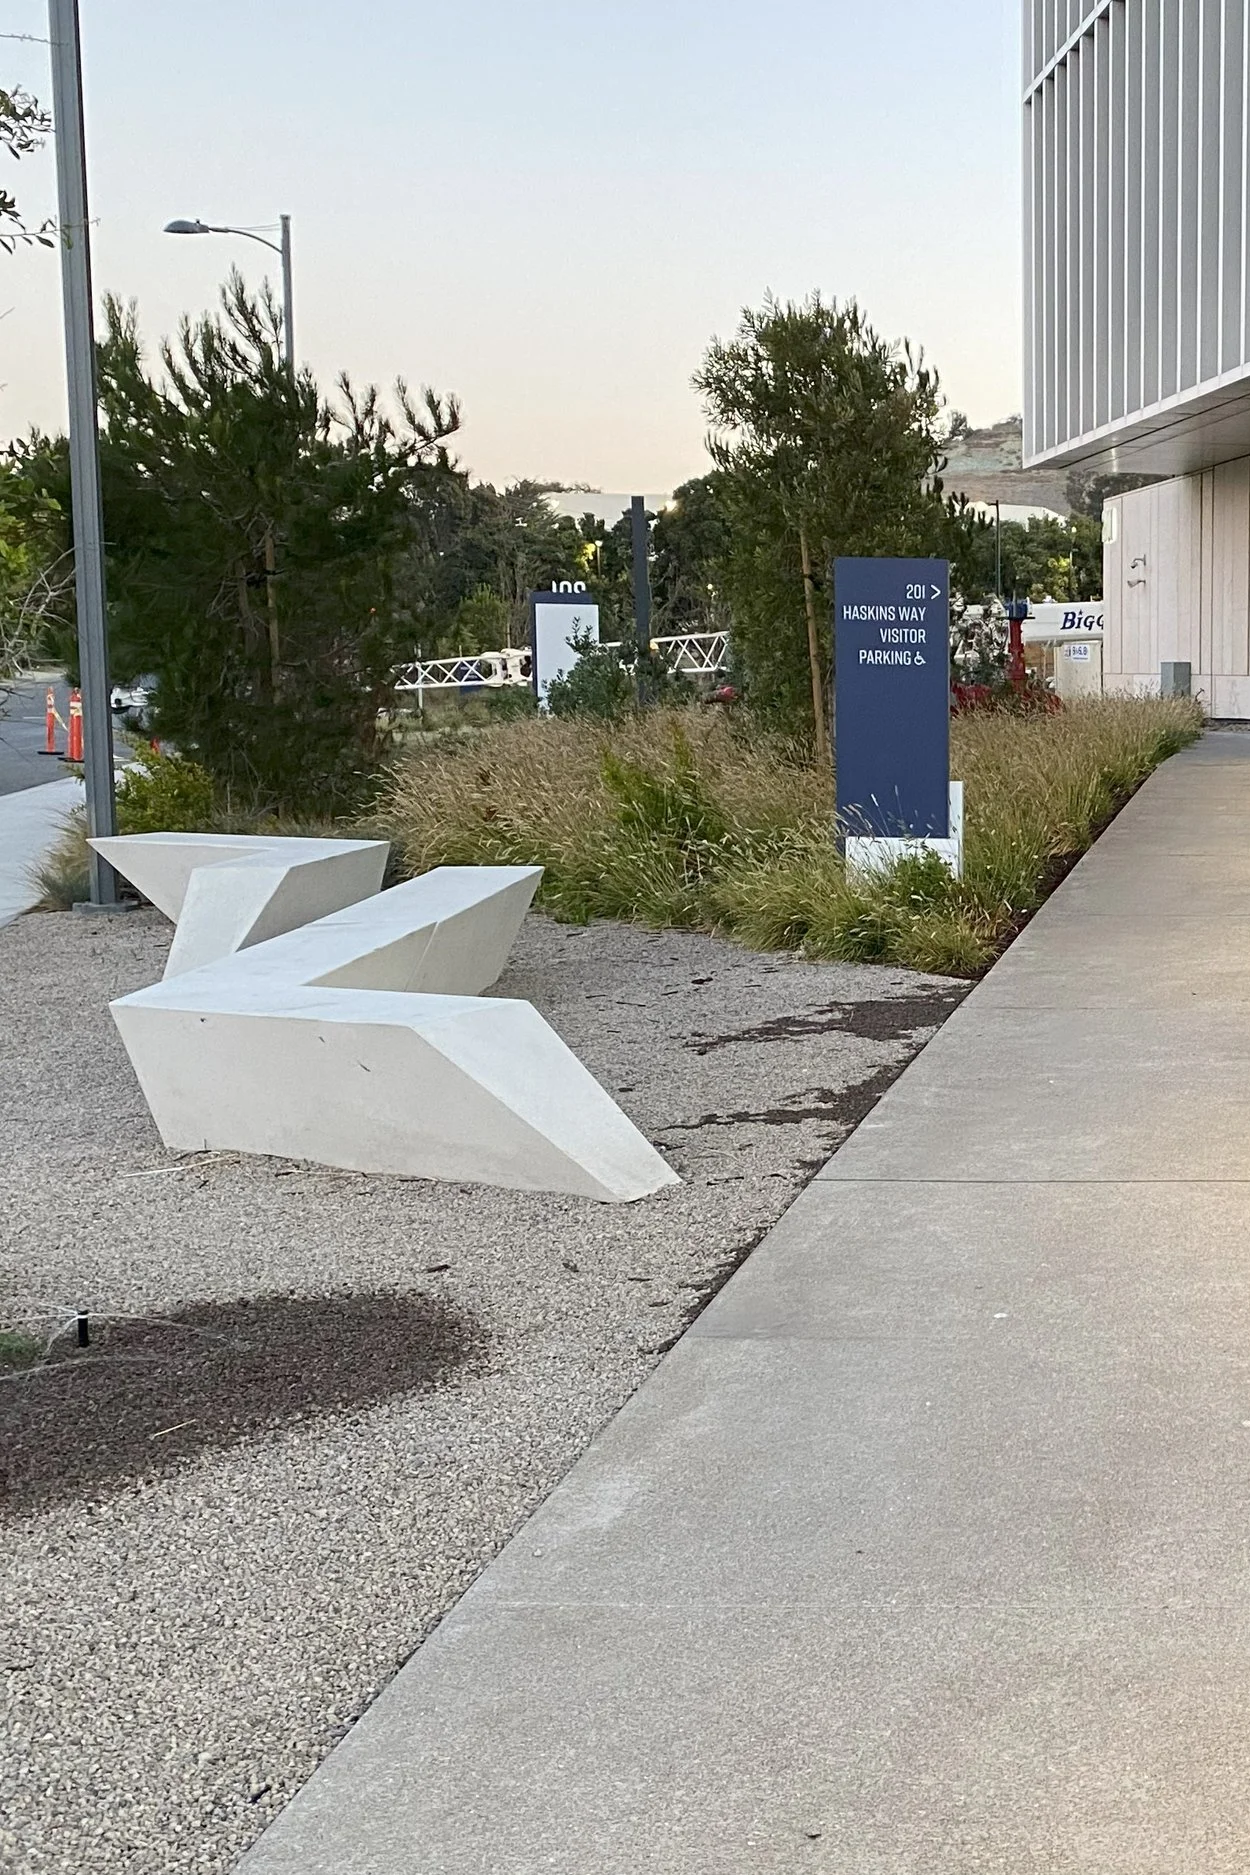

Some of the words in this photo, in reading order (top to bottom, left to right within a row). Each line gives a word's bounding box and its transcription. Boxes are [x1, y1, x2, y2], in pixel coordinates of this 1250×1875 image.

[906, 583, 926, 600] 201
[843, 605, 896, 621] HASKINS
[898, 606, 926, 621] WAY
[879, 627, 926, 643] VISITOR
[859, 649, 911, 666] PARKING
